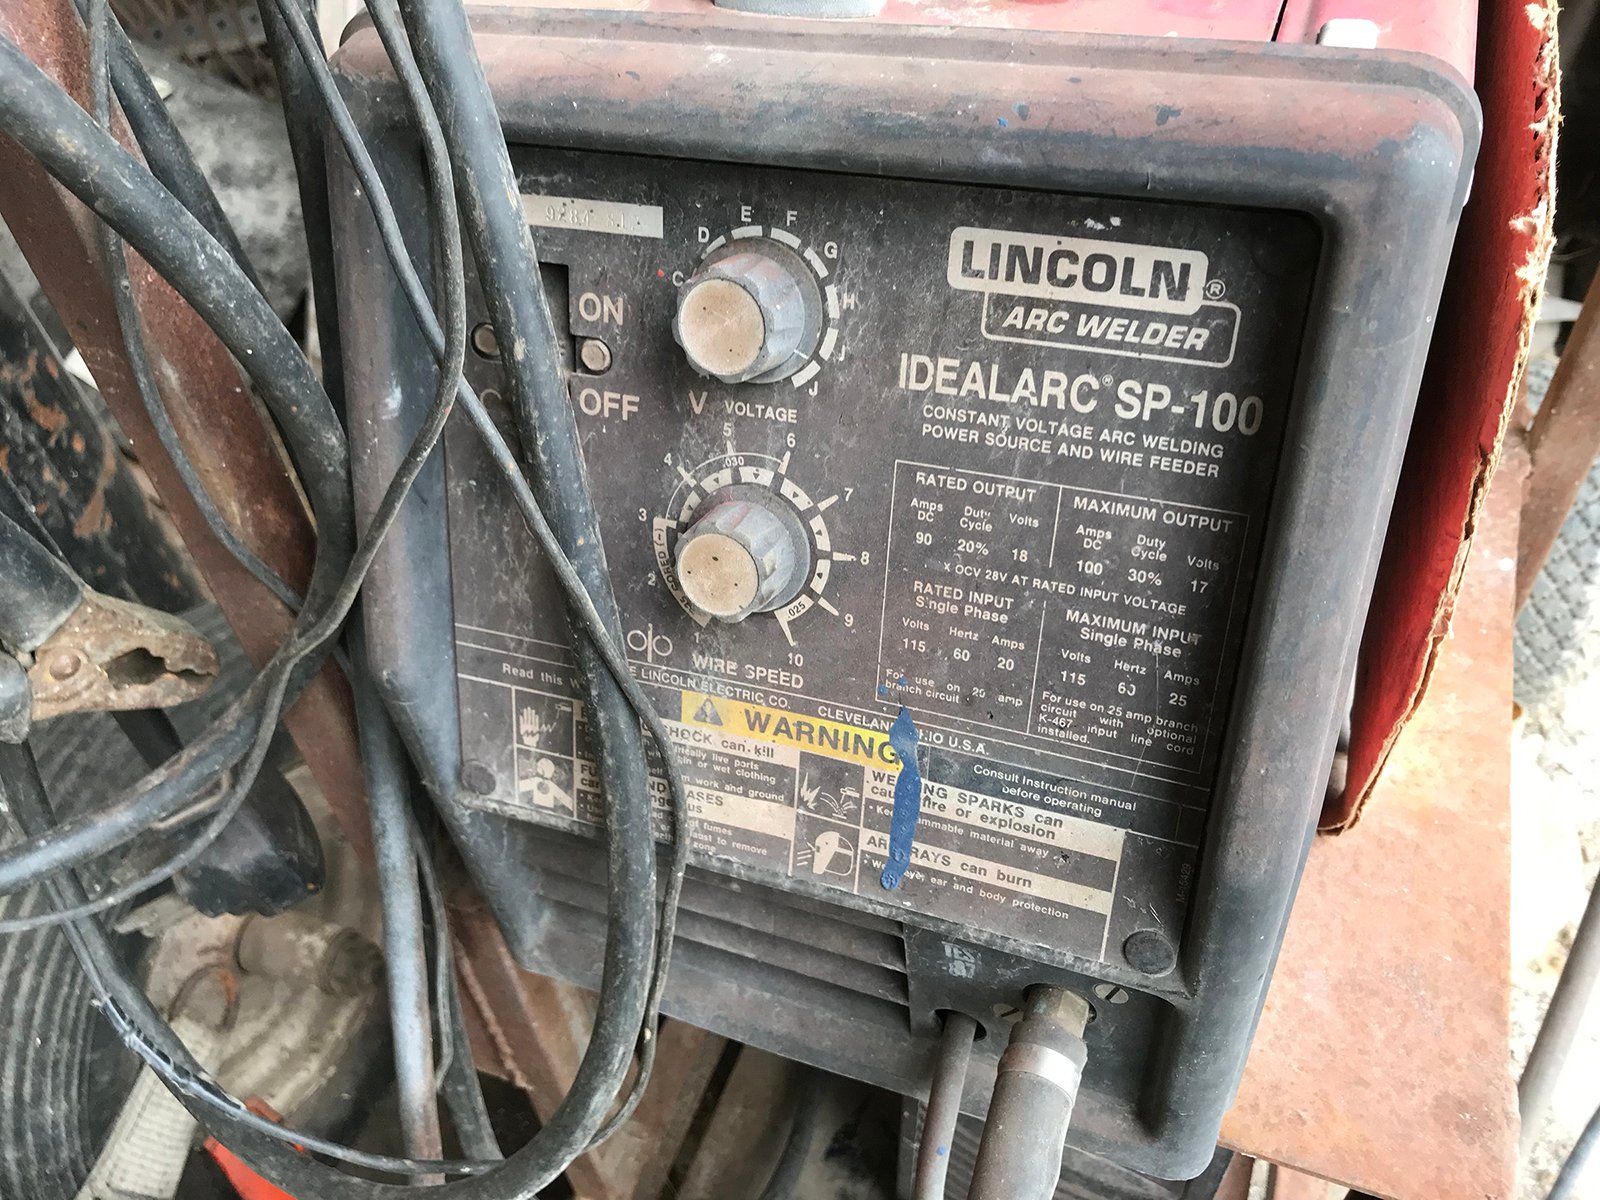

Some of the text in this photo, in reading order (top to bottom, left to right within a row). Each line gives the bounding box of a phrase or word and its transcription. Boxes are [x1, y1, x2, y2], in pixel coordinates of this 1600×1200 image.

[741, 205, 752, 222] E
[786, 210, 798, 227] F
[698, 226, 710, 243] D
[824, 241, 838, 259] G
[960, 239, 1192, 302] LINCOLN
[578, 292, 624, 326] ON
[842, 292, 855, 310] H
[1001, 306, 1210, 351] ARC WELDER
[808, 381, 819, 396] J
[579, 388, 640, 421] OFF
[725, 400, 798, 423] VOLTAGE
[1114, 379, 1264, 436] SP-100
[723, 423, 732, 437] 5
[786, 433, 796, 448] 6
[922, 404, 1224, 459] CONSTANT VOLTAGE ARC WELDING
[663, 453, 673, 466] 4
[922, 424, 1220, 478] POWER SOURCE AND WIRE FEEDER
[844, 487, 854, 502] 7
[916, 472, 1037, 502] RATED OUTPUT
[638, 508, 648, 521] 3
[910, 497, 944, 512] Amps
[917, 510, 935, 522] DC
[1073, 496, 1233, 533] MAXIMUM OUTPUT
[959, 517, 993, 532] Cycle
[1009, 513, 1040, 528] Volts
[1076, 524, 1112, 541] Amps
[915, 532, 1029, 563] 90 20% 18
[1083, 538, 1102, 550] DC
[1131, 546, 1168, 562] Cycle
[1136, 534, 1167, 550] Duty
[860, 551, 870, 566] 8
[1187, 555, 1220, 572] Volts
[648, 573, 656, 586] 2
[1076, 559, 1209, 594] 100 30% 17
[913, 580, 1015, 610] RATED INPUT
[955, 563, 1187, 616] OCV 28V AT RATED INPUT VOLTAGE
[844, 613, 854, 627] 9
[964, 604, 1009, 624] Phase
[902, 617, 1026, 651] Volts Hertz Amps
[1065, 609, 1203, 645] MAXIMUM INPUT
[903, 637, 1015, 671] 115 60 20
[1080, 626, 1182, 658] Single Phase
[692, 653, 804, 689] WIRE SPEED
[788, 652, 804, 667] 10
[1060, 648, 1200, 687] Volts Hertz Amps
[502, 662, 534, 679] Read
[540, 672, 563, 686] this
[915, 677, 935, 687] use
[946, 683, 961, 693] on
[997, 694, 1023, 708] amp
[925, 688, 960, 704] circuit
[1060, 670, 1086, 686] 115
[1168, 692, 1188, 707] 25
[641, 670, 696, 689] LINCOLN
[701, 680, 764, 704] ELECTRIC
[768, 695, 791, 710] CO.
[817, 705, 895, 731] CLEVELAN
[948, 736, 990, 756] U.S.A.
[1040, 704, 1197, 744] circuit with optional
[1042, 691, 1199, 733] For use on 25 amp branch
[664, 724, 713, 745] HOCK
[721, 739, 746, 752] can
[754, 744, 774, 758] kill
[743, 708, 900, 766] WARNING
[1037, 724, 1090, 744] installed.
[1039, 714, 1194, 756] K-467 input line cord
[712, 753, 729, 764] live
[697, 760, 708, 769] or
[713, 764, 731, 774] wet
[735, 768, 776, 785] clothing
[686, 790, 724, 807] ASES
[695, 777, 720, 789] work
[724, 783, 743, 794] and
[748, 789, 785, 802] ground
[973, 763, 1137, 812] Consult Instruction manual
[957, 791, 1064, 829] SPARKS can
[1043, 795, 1102, 818] operating
[703, 822, 733, 836] fumes
[955, 806, 972, 818] or
[980, 812, 1056, 841] explosion
[717, 836, 768, 856] to remove
[969, 829, 1049, 859] material away
[910, 846, 952, 867] RAYS
[960, 860, 987, 877] can
[996, 868, 1032, 889] burn
[930, 876, 1069, 920] ear and body protection
